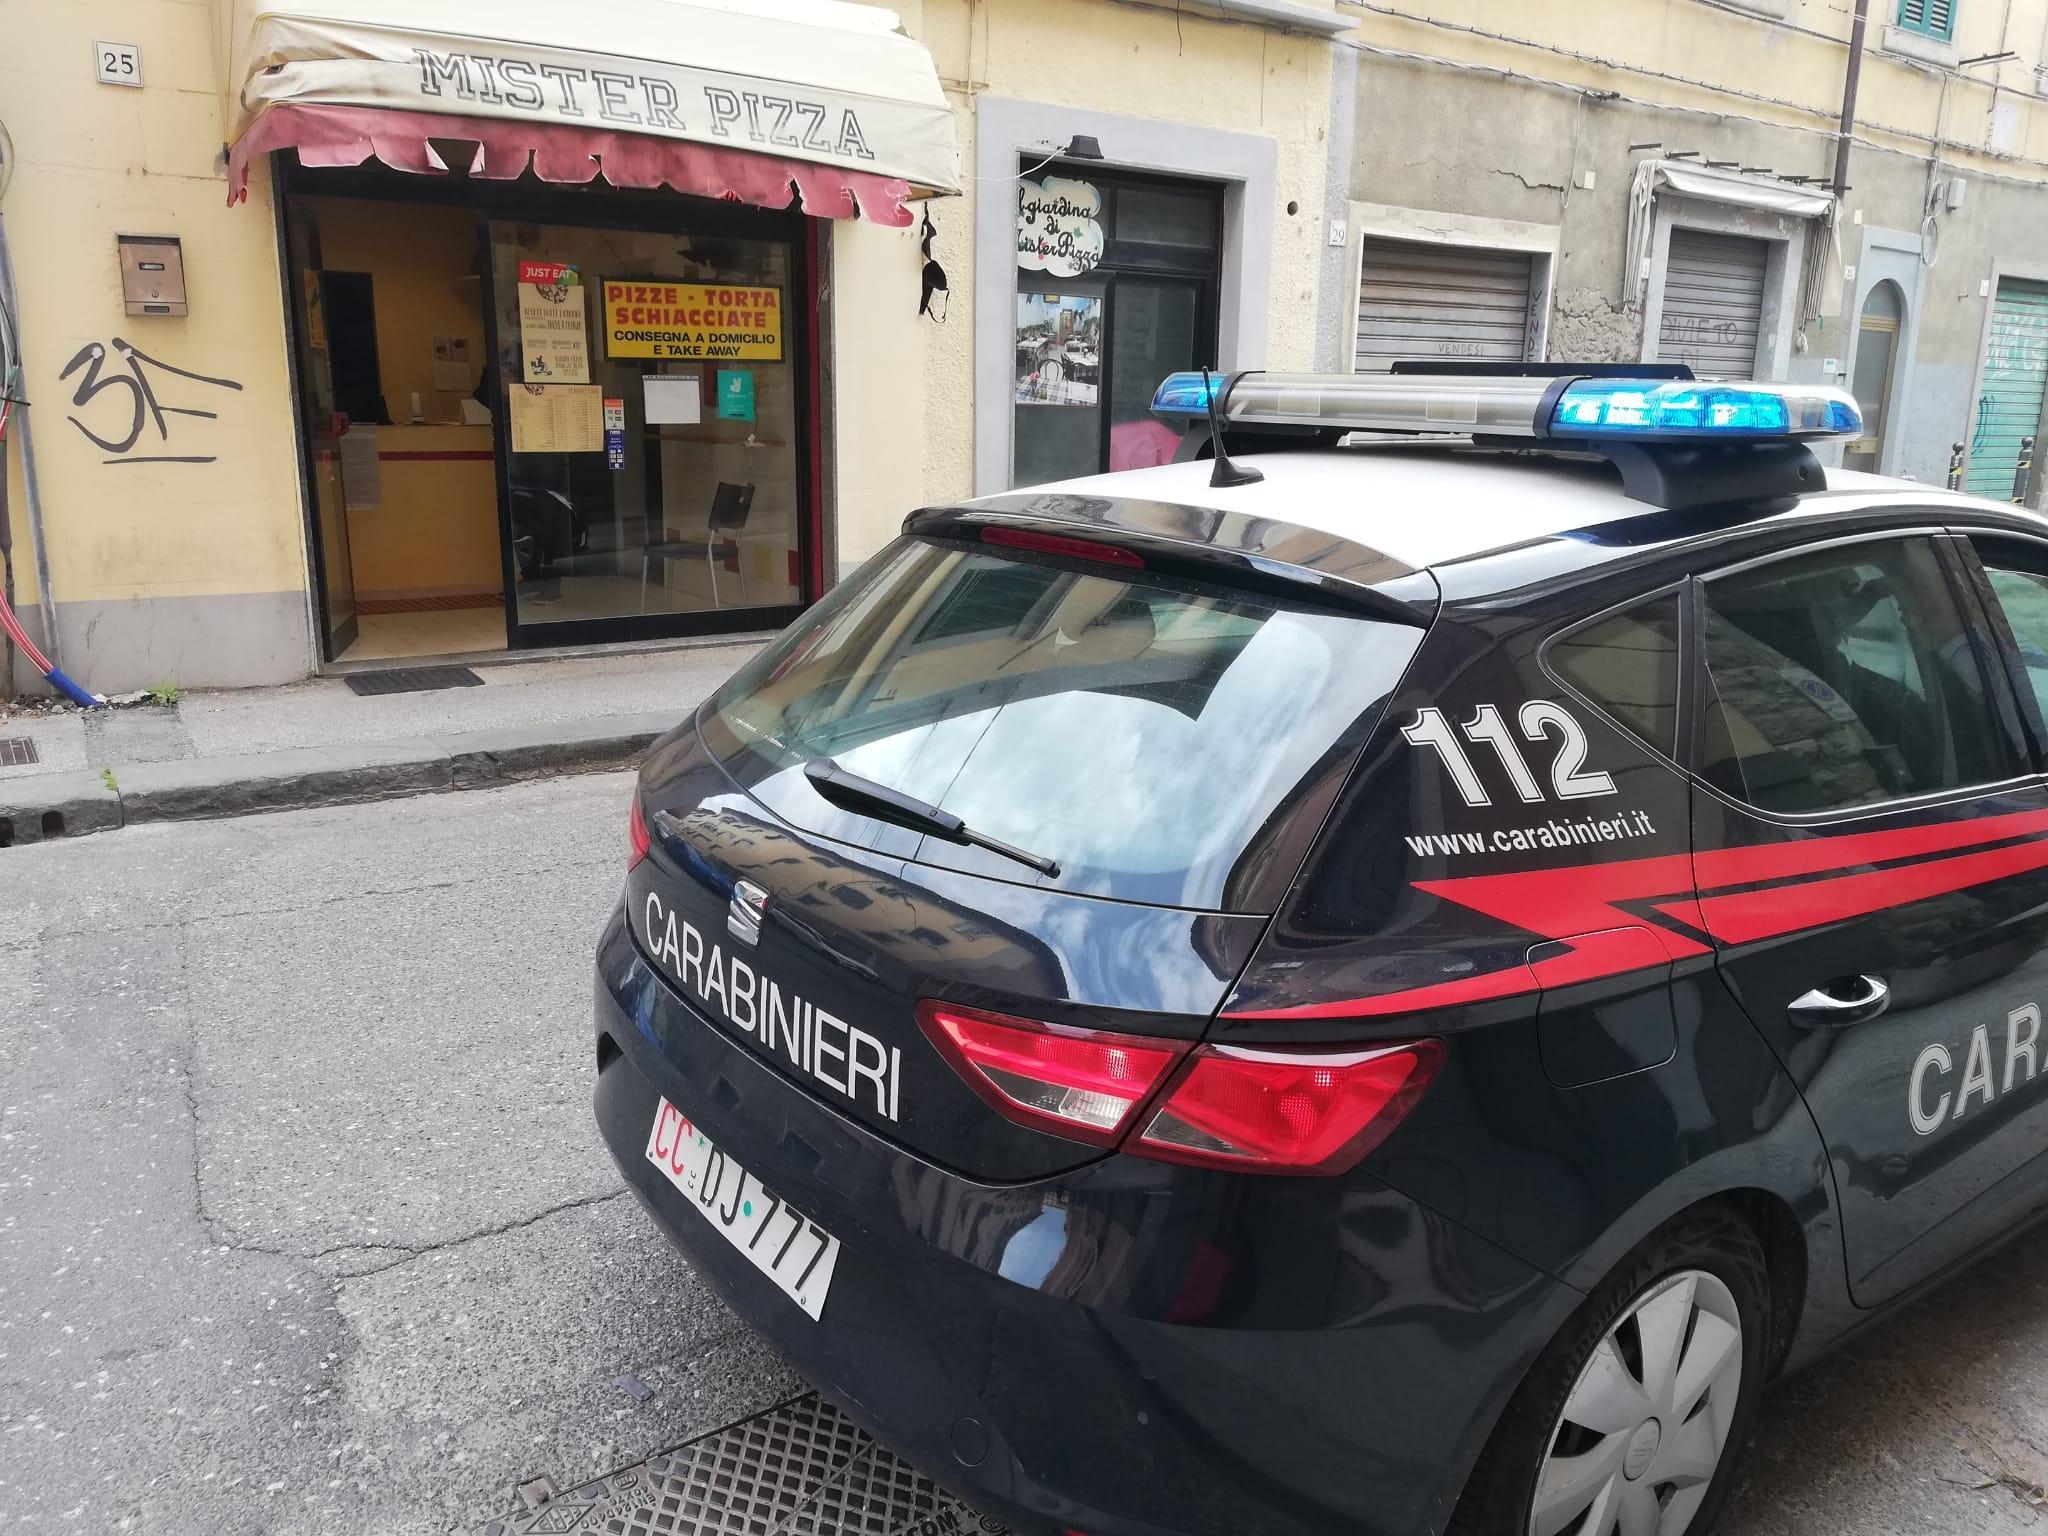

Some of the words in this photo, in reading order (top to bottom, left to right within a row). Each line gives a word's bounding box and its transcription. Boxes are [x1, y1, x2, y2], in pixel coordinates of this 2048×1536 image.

[104, 52, 133, 75] 25
[412, 47, 687, 131] MISTER
[704, 86, 876, 161] PIZZA
[1044, 215, 1060, 235] di
[1331, 227, 1345, 243] 29
[526, 267, 551, 278] JUST
[552, 268, 571, 279] EAT
[608, 285, 678, 304] PIZZE
[704, 289, 777, 308] TORTA
[615, 307, 767, 328] SCHIACCIATE
[614, 330, 691, 343] CONSEGNA
[695, 333, 705, 343] A
[708, 333, 776, 344] DOMICILIO
[653, 344, 663, 355] E
[667, 344, 702, 356] TAKE
[706, 346, 741, 356] AWAY
[1438, 343, 1484, 358] VENDESI
[1400, 700, 1618, 807] 112
[1405, 810, 1657, 857] www.carabinieri.it
[646, 891, 901, 1122] CARABINIERI
[1909, 1003, 2048, 1135] CAR
